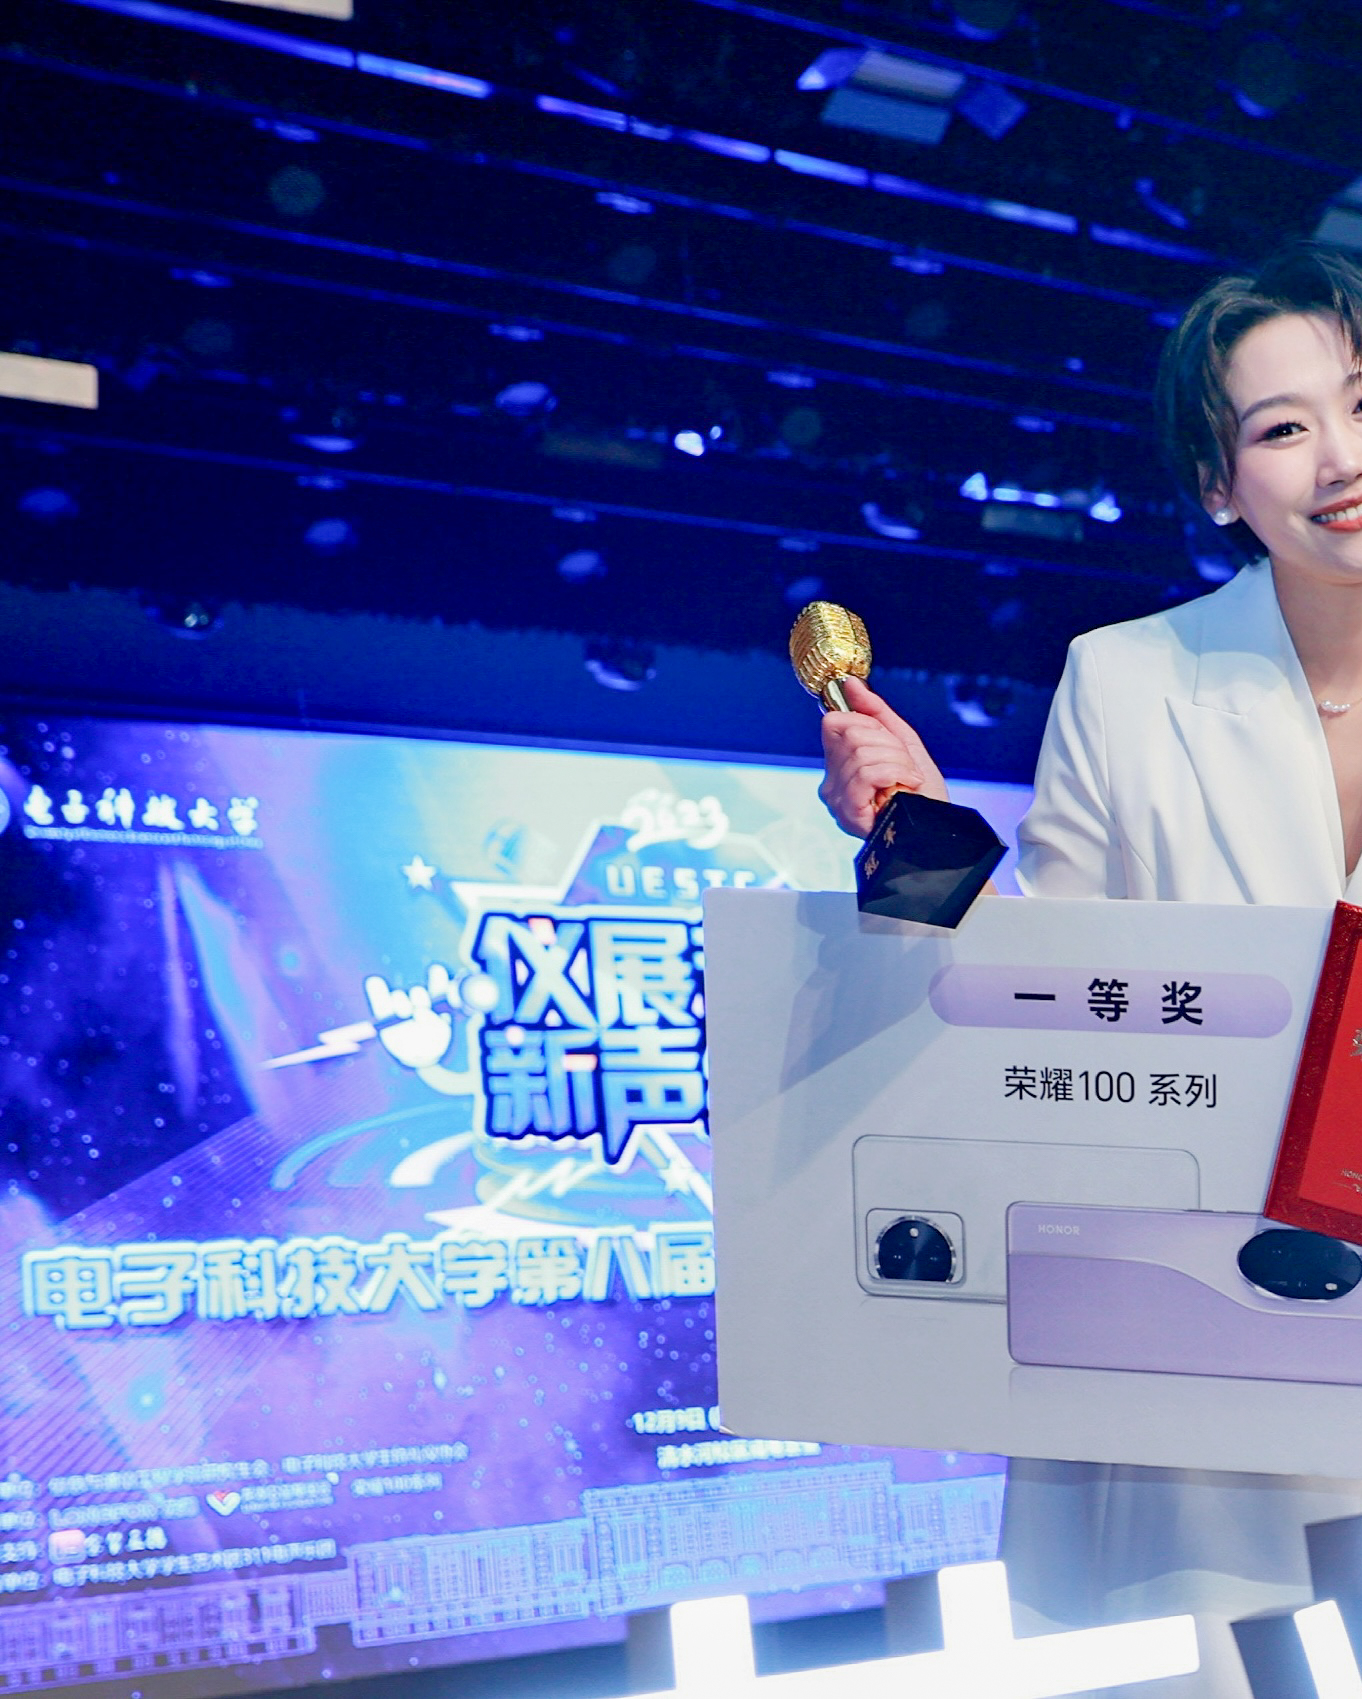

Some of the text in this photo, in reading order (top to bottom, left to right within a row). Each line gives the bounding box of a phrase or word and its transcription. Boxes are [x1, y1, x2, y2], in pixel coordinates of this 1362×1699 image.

[472, 914, 704, 1028] 仪展
[1014, 978, 1203, 1026] 一等奖
[1004, 1065, 1218, 1109] 荣耀100 系列
[1037, 1223, 1081, 1236] HONOR
[26, 1226, 716, 1329] 电子科技大学第八届
